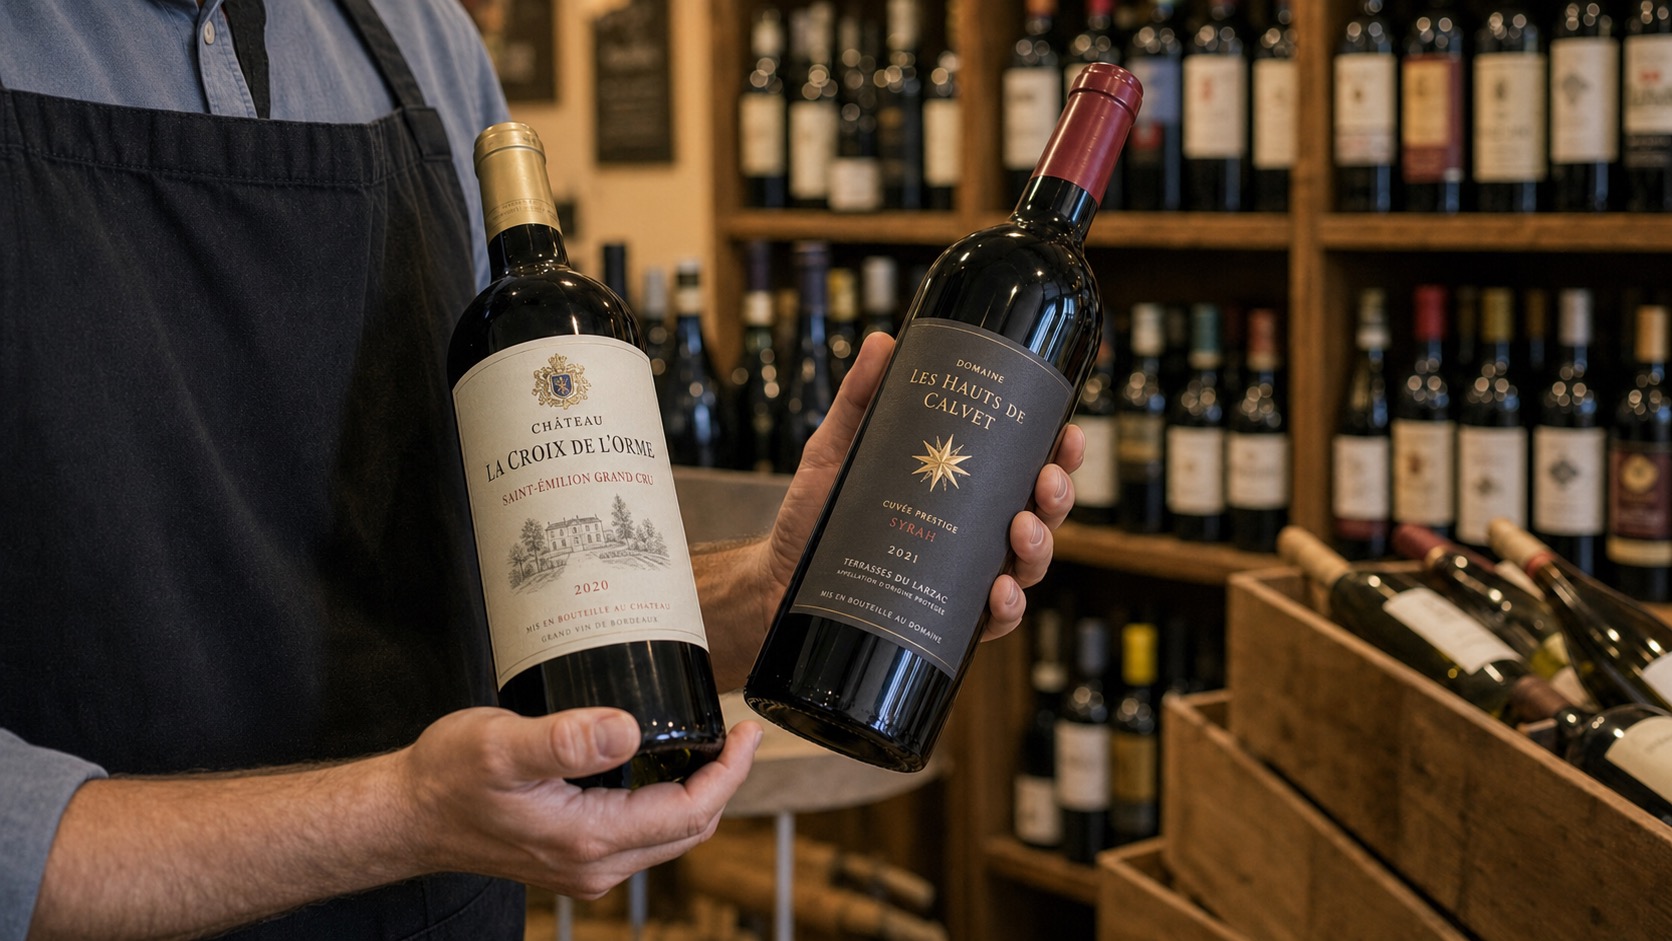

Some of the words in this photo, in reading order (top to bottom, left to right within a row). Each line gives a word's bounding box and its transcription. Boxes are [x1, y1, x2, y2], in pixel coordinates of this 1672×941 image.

[956, 359, 1005, 384] DOMAINE
[910, 368, 938, 386] LES
[942, 373, 1003, 410] HAUTS
[1005, 403, 1026, 425] DE
[924, 392, 996, 430] CALVET
[531, 415, 603, 434] CHÂTEAU
[486, 459, 505, 482] LA
[508, 439, 567, 470] CROIX
[571, 438, 595, 455] DE
[599, 434, 655, 459] L'ORME
[502, 472, 591, 506] SAINT-ÉMILION
[594, 471, 634, 483] GRAND
[635, 473, 654, 486] CRU
[882, 500, 913, 515] CUVÉE
[915, 510, 959, 534] PRESTIGE
[889, 517, 937, 543] SYRAH
[887, 545, 918, 564] 2021
[574, 579, 609, 595] 2020
[843, 557, 893, 579] TERRASSES
[894, 574, 910, 586] DU
[912, 580, 949, 605] LARZAC
[526, 622, 540, 635] MIS
[543, 617, 555, 628] EN
[557, 605, 611, 624] BOUTEILLE
[614, 604, 626, 613] AU
[541, 627, 572, 643] GRAND
[574, 623, 592, 633] VIN
[595, 620, 607, 629] DE
[610, 616, 659, 626] BORDEAUX
[820, 590, 833, 599] MIS
[835, 593, 846, 602] EN
[847, 595, 893, 619] BOUTEILLE
[894, 614, 907, 625] AU
[908, 620, 943, 645] DOMAINE
